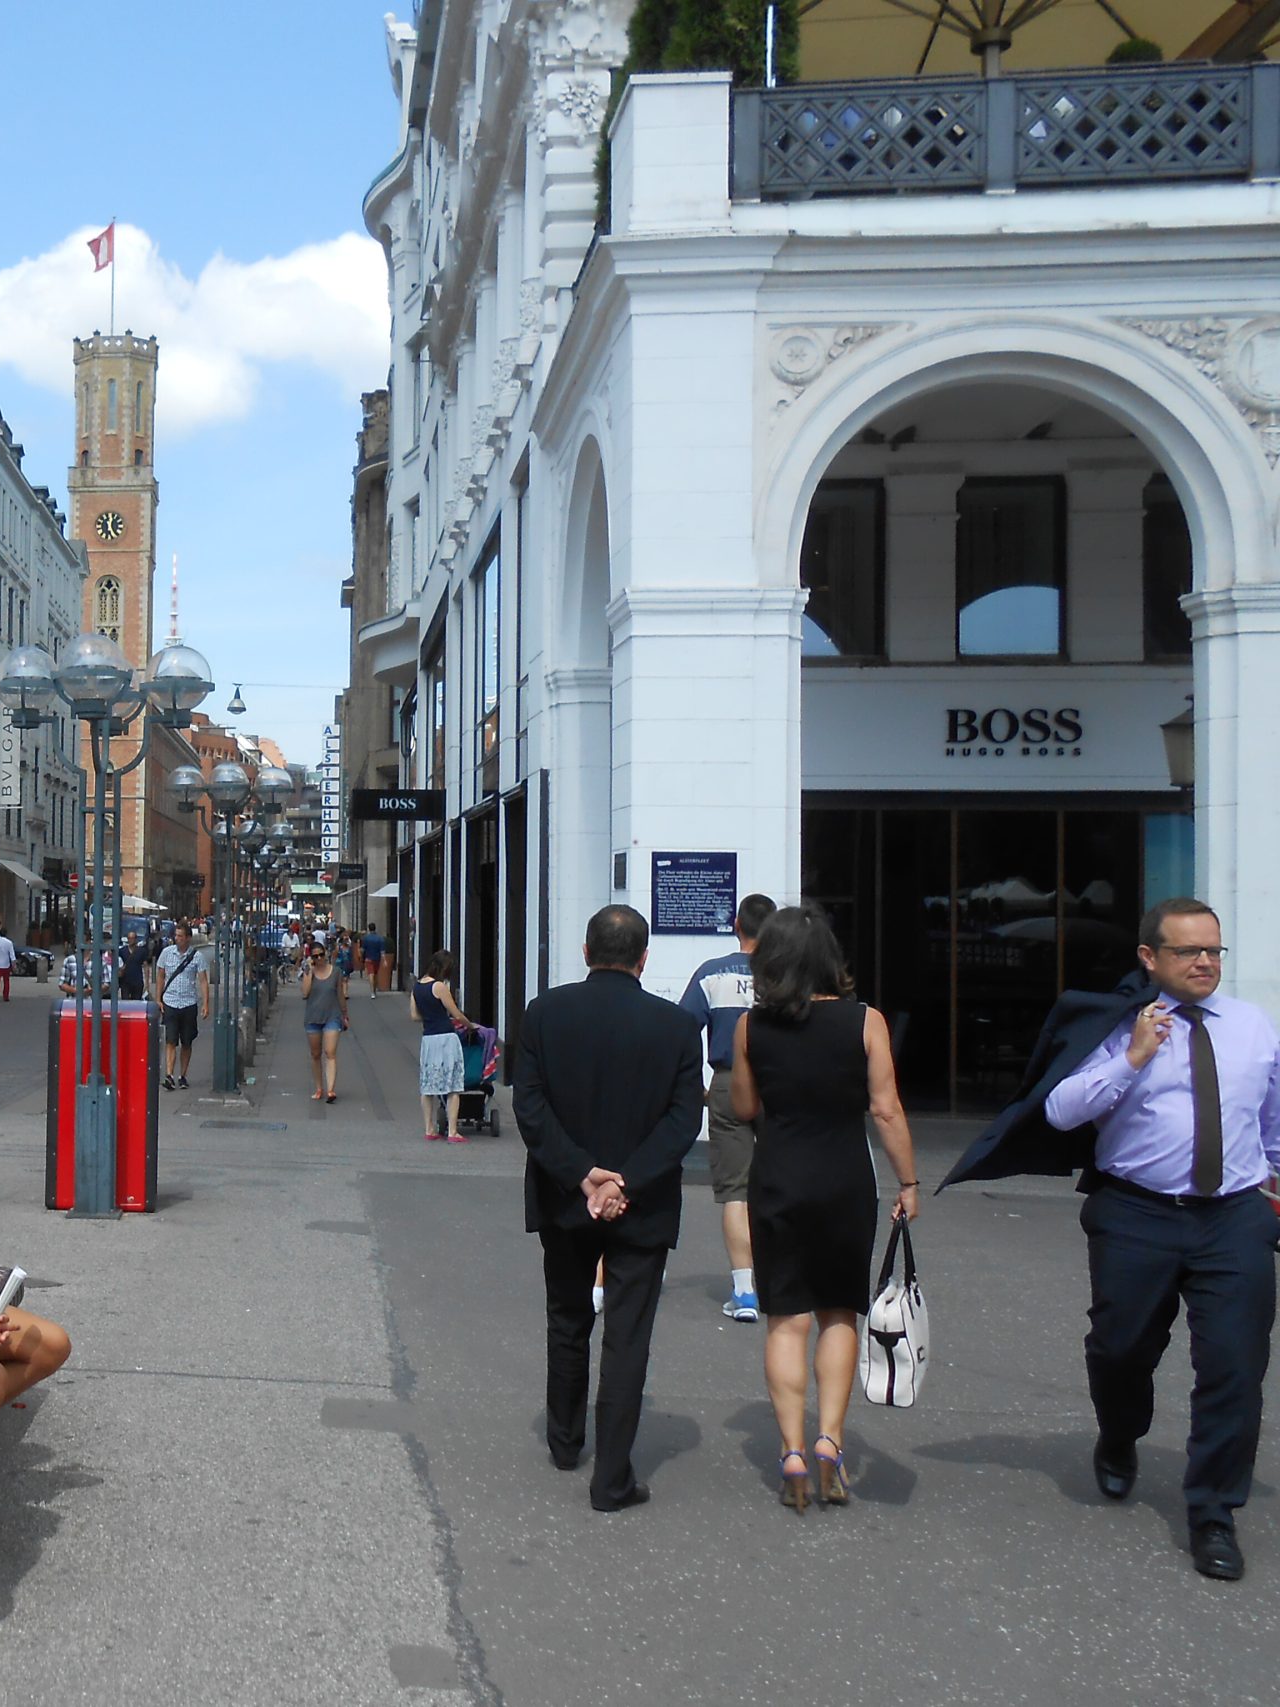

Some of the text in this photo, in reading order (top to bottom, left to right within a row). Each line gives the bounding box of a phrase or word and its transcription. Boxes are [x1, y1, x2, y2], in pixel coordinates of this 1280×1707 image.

[945, 708, 1083, 744] BOSS
[2, 706, 15, 797] BVLGAR
[945, 747, 1082, 757] HUGO BOSS
[322, 725, 333, 862] ALSTERHAUS
[379, 798, 417, 810] BOSS
